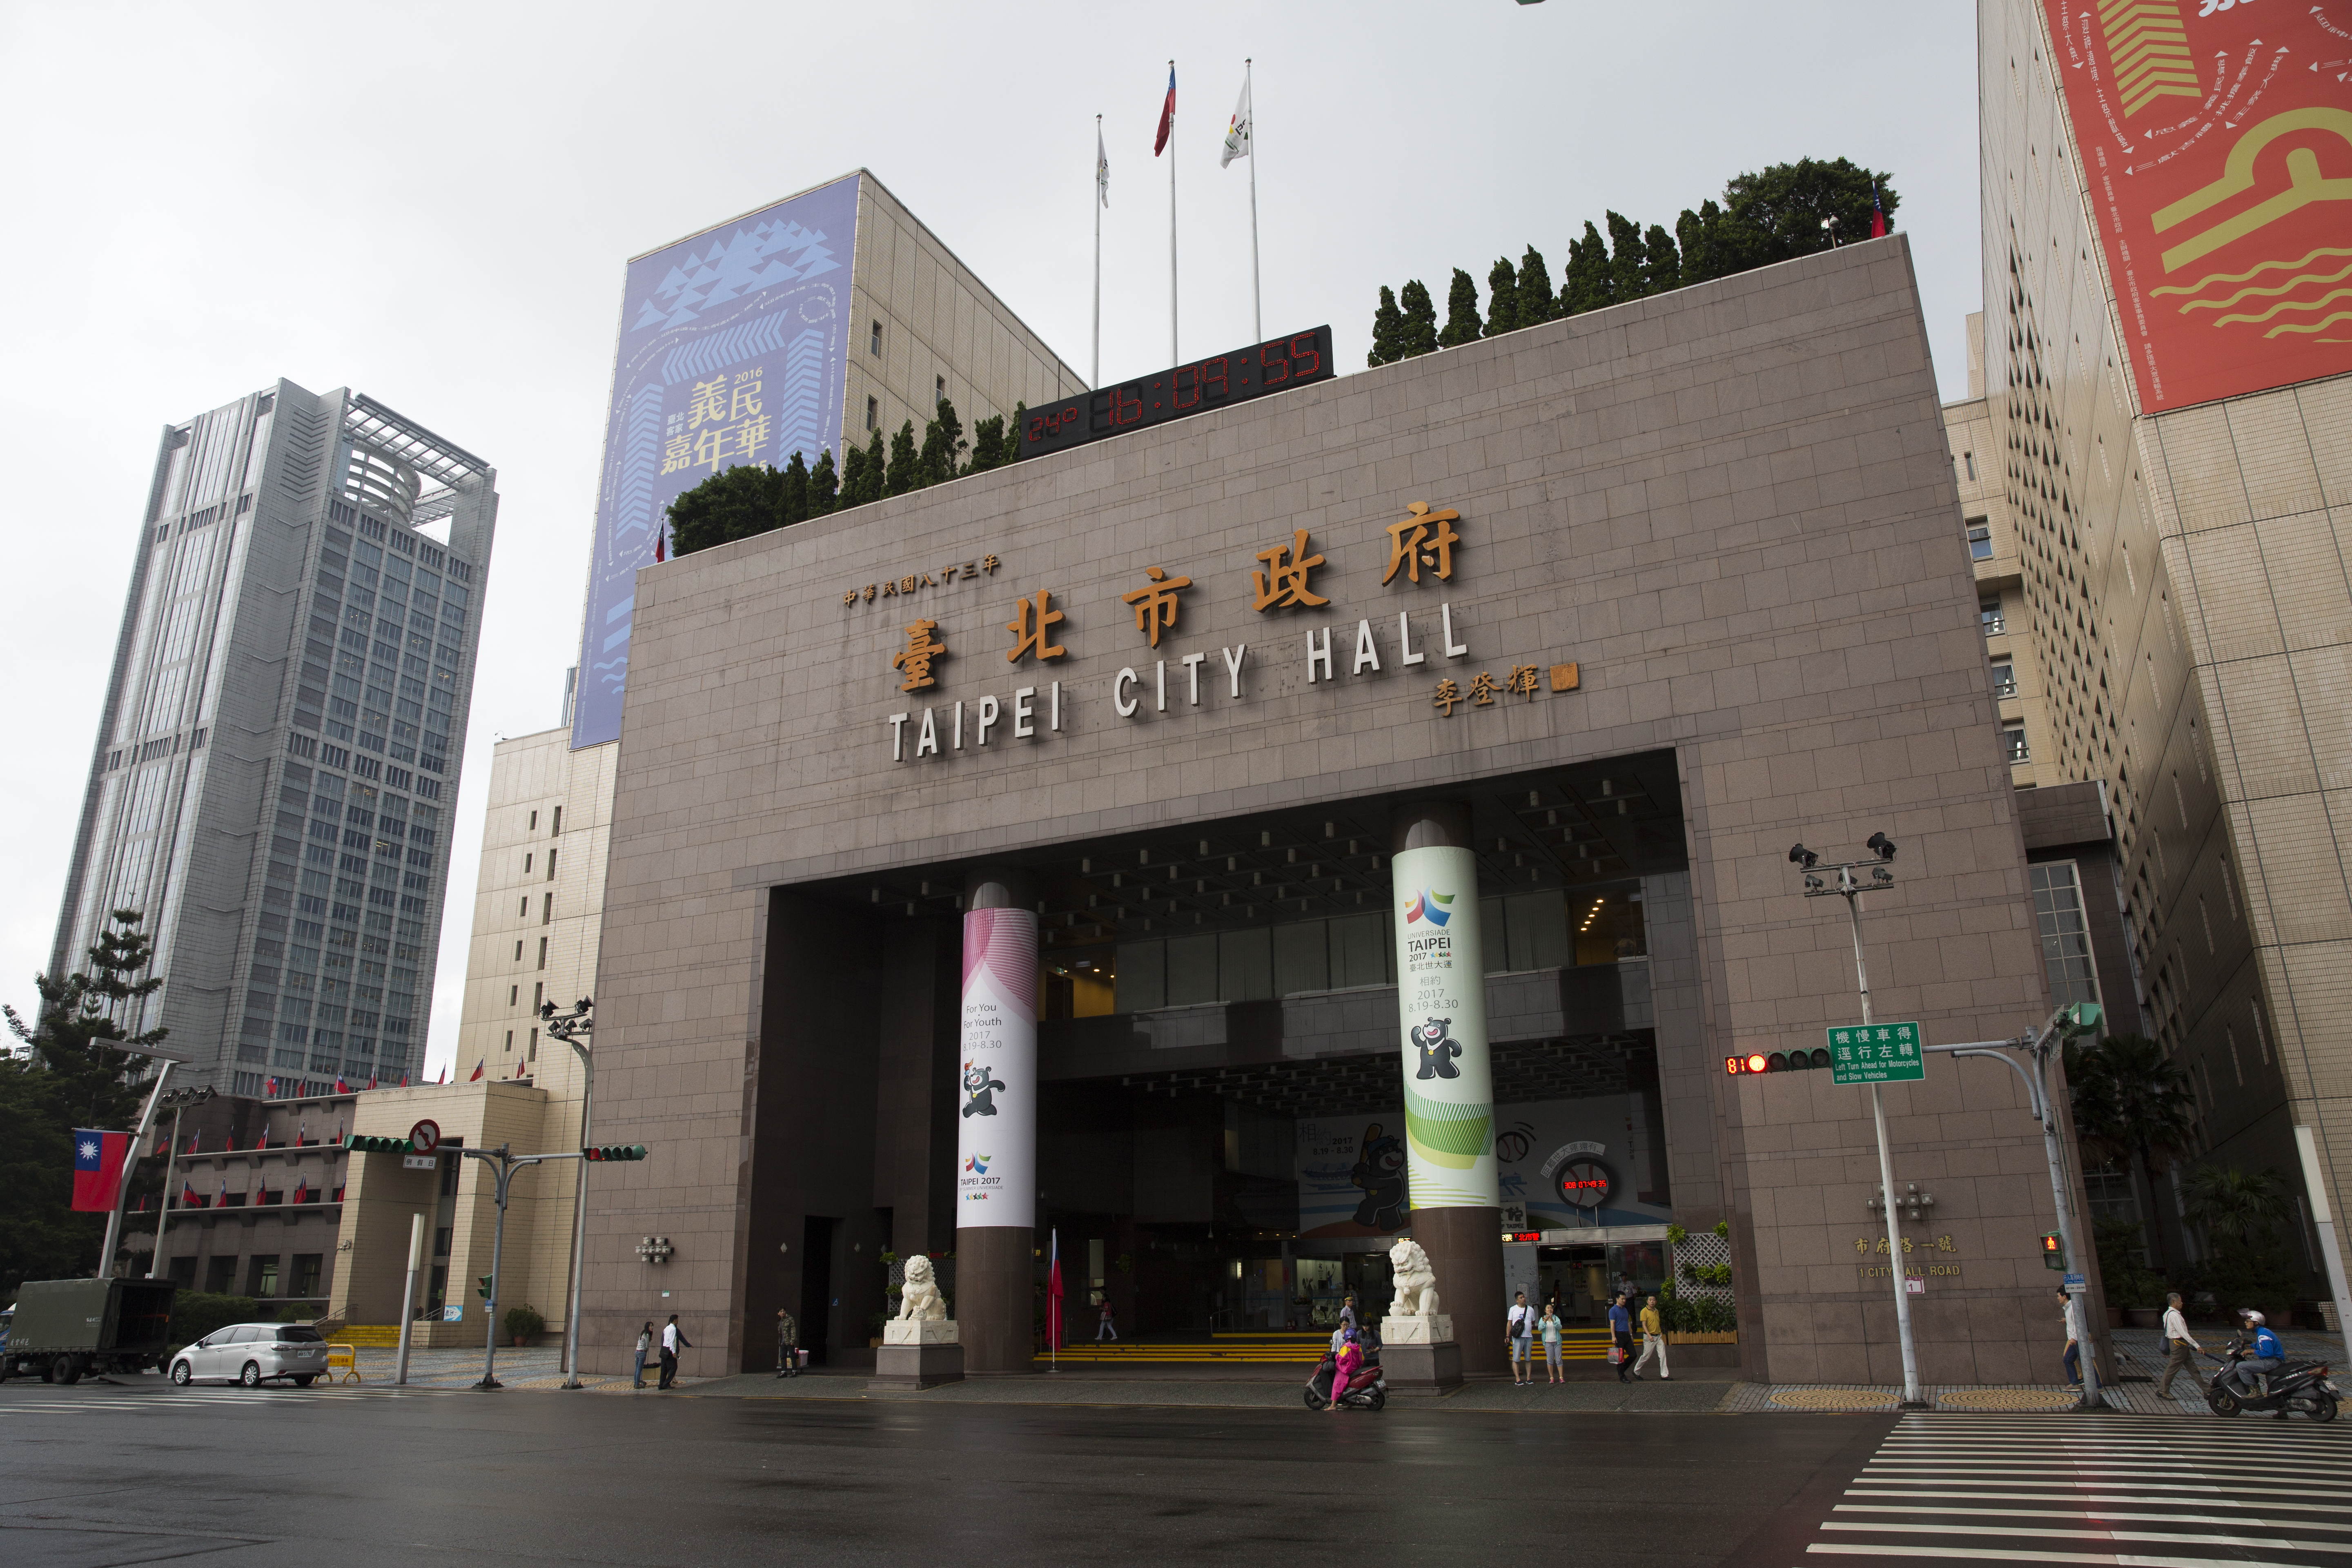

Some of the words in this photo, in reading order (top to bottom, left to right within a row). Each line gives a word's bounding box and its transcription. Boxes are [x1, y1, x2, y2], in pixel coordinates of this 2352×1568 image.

[2314, 13, 2352, 40] 迎神
[734, 367, 763, 384] 2016
[1108, 332, 1319, 425] 16:09:55
[688, 374, 762, 429] 義民
[667, 412, 684, 425] 臺北
[666, 423, 684, 437] 客家
[660, 414, 771, 476] 嘉年華
[843, 554, 1000, 608] 中華民國八十三年
[893, 501, 1461, 693] 臺北市政府
[890, 681, 1062, 762] TAIPEI
[1114, 644, 1248, 719] CITY
[1307, 603, 1470, 685] HALL
[1433, 663, 1539, 717] 李登輝
[1408, 929, 1450, 939] UNIVERSIADE
[1408, 937, 1450, 952] TAIPEI
[1409, 952, 1427, 962] 2017
[1410, 960, 1452, 972] 臺北世大運
[1420, 976, 1441, 987] 相約
[1418, 989, 1444, 1000] 2017
[979, 1003, 996, 1011] You
[1409, 999, 1458, 1013] 8.19-8.30
[964, 1021, 973, 1029] For
[974, 1017, 1001, 1027] Youth
[969, 1031, 990, 1040] 2017
[1835, 1027, 1911, 1044] 機慢車得
[963, 1040, 1002, 1051] 8.19-8.30
[1838, 1043, 1913, 1060] 逕行左轉
[1727, 1058, 1745, 1074] 81
[1861, 1061, 1877, 1069] Ahead
[1888, 1058, 1919, 1068] Motorcycles
[1849, 1072, 1862, 1080] Slow
[1299, 1123, 1332, 1146] 相約
[961, 1178, 978, 1186] TAIPEI
[1854, 1235, 1957, 1255] 市府路一號
[1859, 1268, 1864, 1277] 1
[1868, 1267, 1892, 1277] CITY
[1905, 1266, 1926, 1276] ALL
[1930, 1265, 1960, 1276] ROAD
